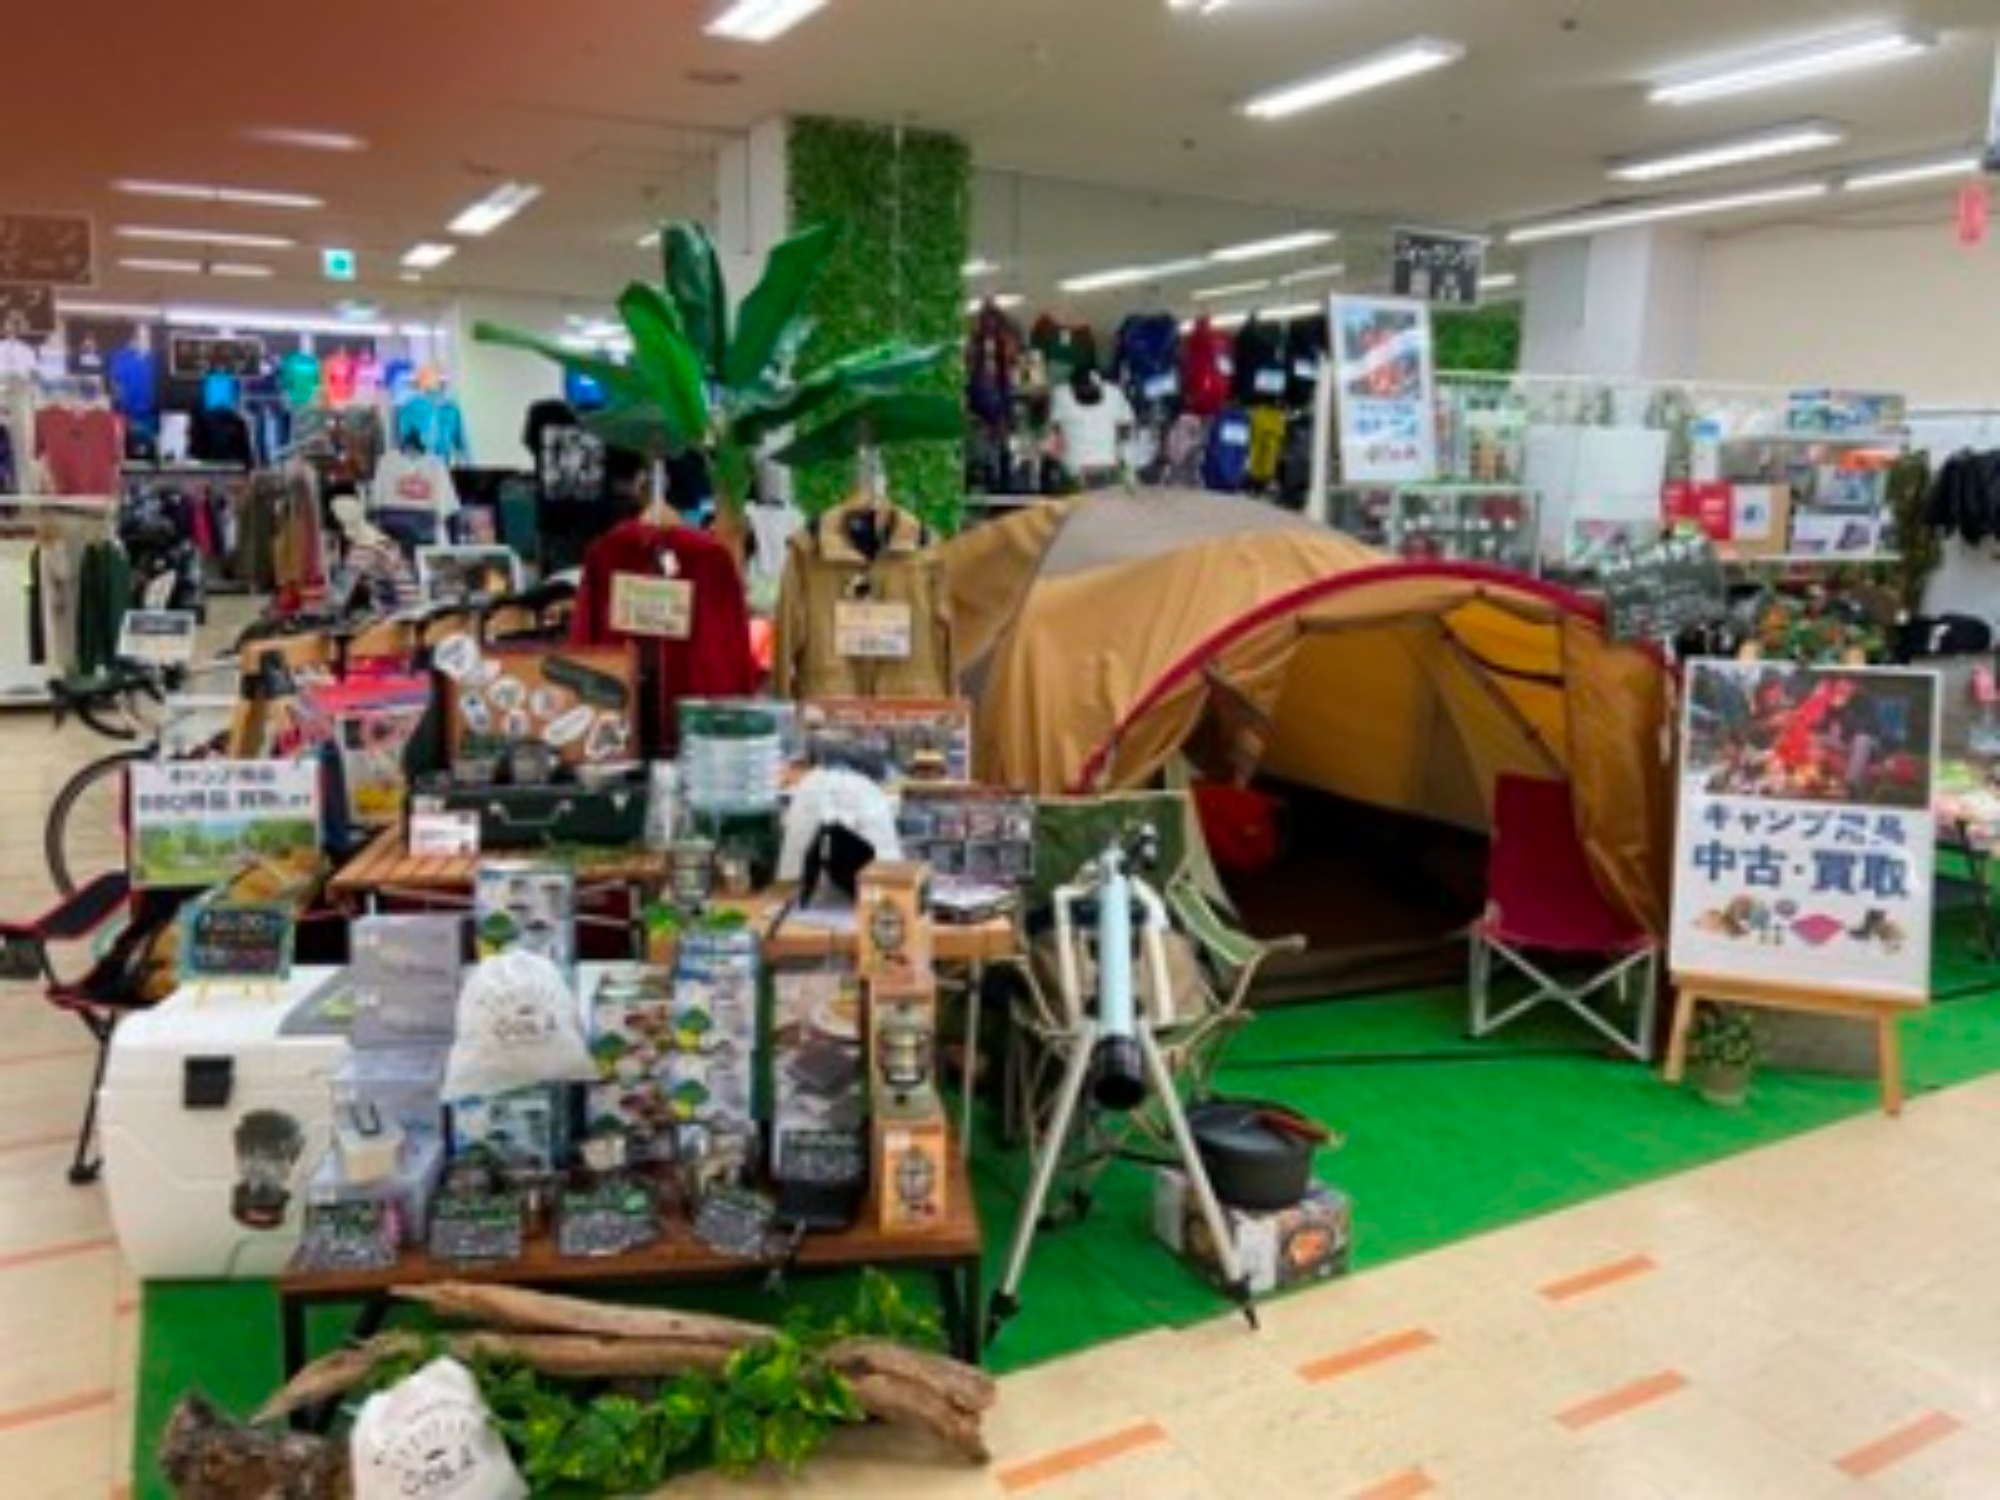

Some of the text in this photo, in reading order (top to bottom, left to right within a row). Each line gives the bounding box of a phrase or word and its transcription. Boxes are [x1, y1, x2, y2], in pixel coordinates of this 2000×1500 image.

[1702, 802, 1907, 846] キャンプ用品
[1693, 839, 1910, 898] 中古・買取
